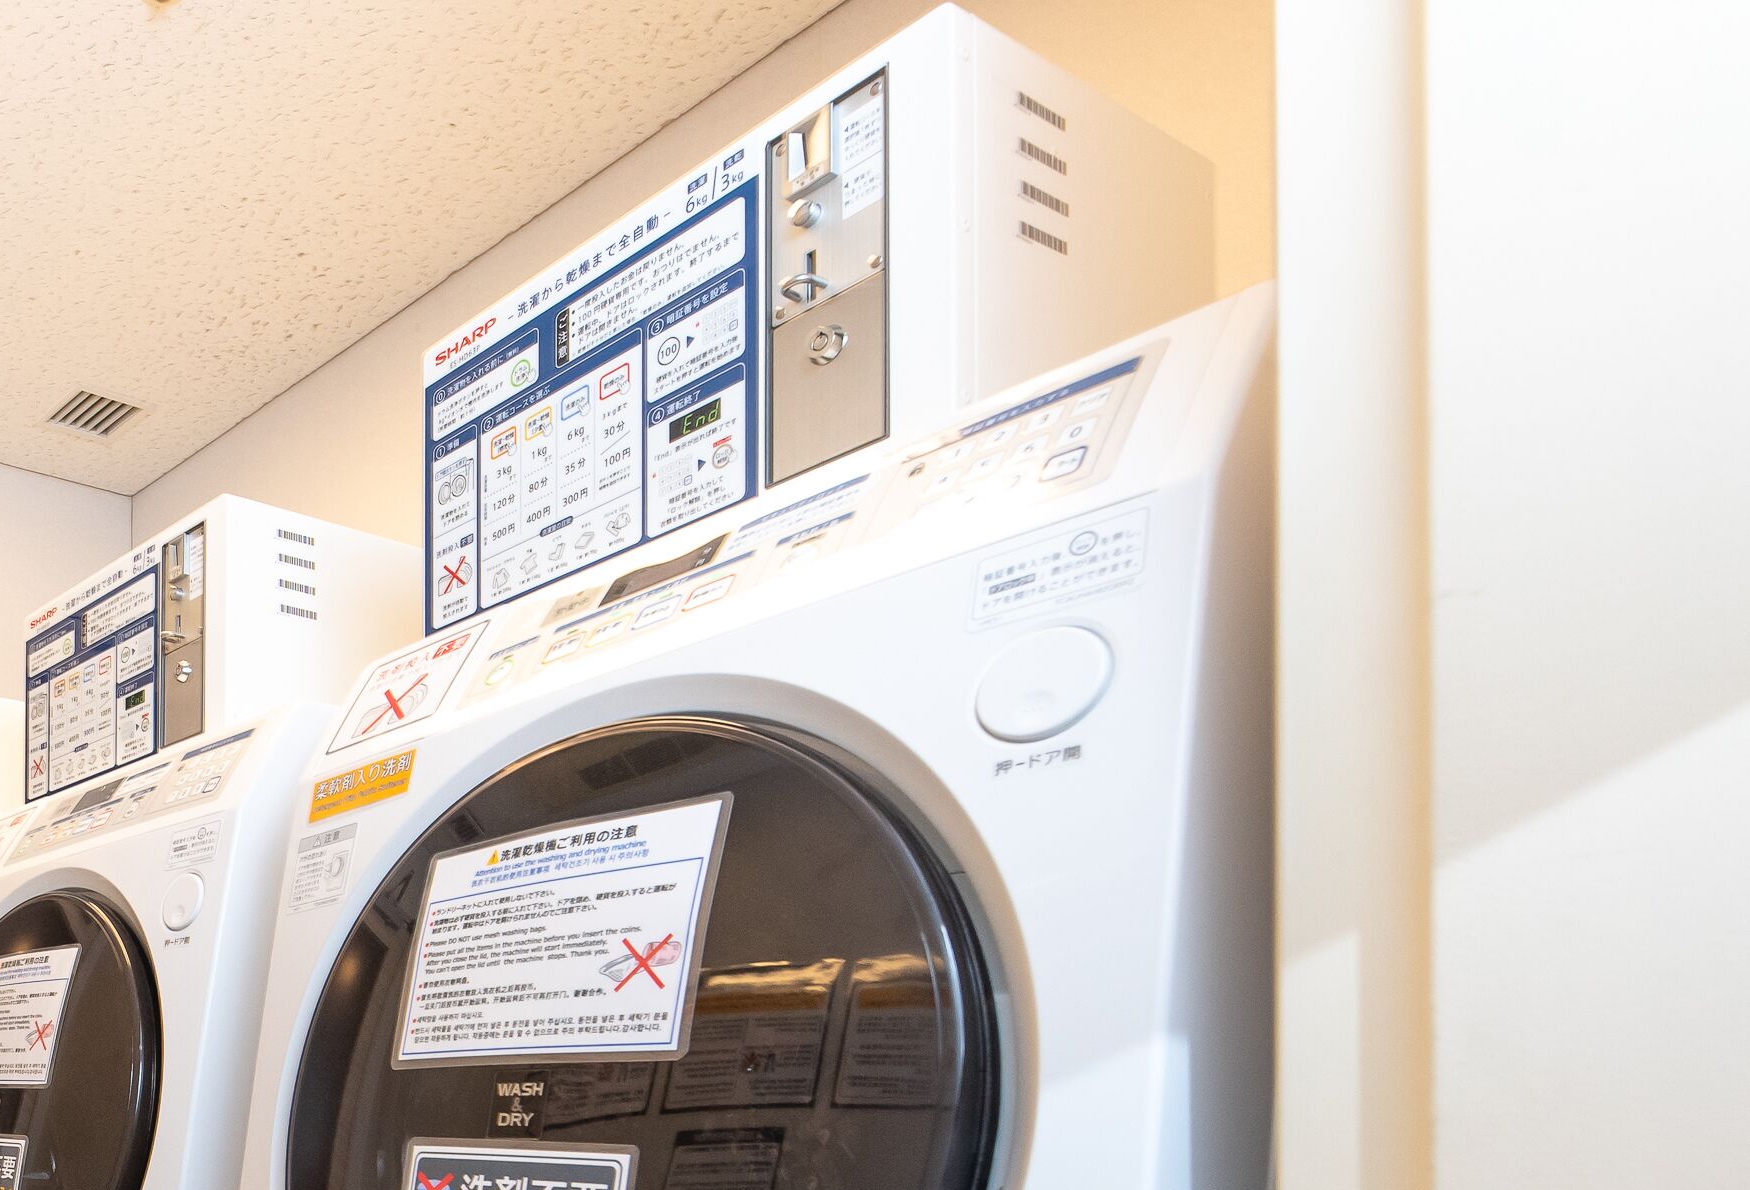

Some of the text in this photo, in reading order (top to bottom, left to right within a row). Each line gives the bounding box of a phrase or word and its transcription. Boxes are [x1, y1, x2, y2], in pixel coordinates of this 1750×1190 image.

[685, 170, 744, 213] 6kg 3kg
[666, 282, 729, 325] 暗証番号を設定
[435, 317, 497, 367] SHARP
[557, 314, 569, 360] ご注意
[660, 344, 677, 360] 100
[495, 386, 551, 424] 運転コースを選ぶ
[666, 390, 701, 417] 運転終了
[682, 399, 721, 436] End
[567, 426, 585, 441] 6kg
[603, 420, 625, 439] 30分
[532, 446, 547, 459] 1kg
[604, 446, 631, 468] 100円
[497, 465, 512, 479] 3kg
[565, 457, 586, 476] 35分
[528, 476, 548, 493] 80分
[492, 493, 516, 512] 120分
[563, 487, 589, 508] 300円
[526, 506, 551, 523] 400円
[492, 522, 516, 541] 500円
[30, 606, 58, 630] SHARP
[314, 750, 413, 802] 柔軟剤入り洗剤
[323, 830, 341, 845] 注意
[500, 824, 639, 862] 洗濯乾燥機ご利用の注意
[474, 840, 647, 878] Attention to use the washing and drying machine
[428, 949, 446, 958] Please
[446, 948, 456, 958] put
[465, 945, 475, 954] the
[476, 943, 494, 952] items
[494, 942, 501, 950] in
[502, 941, 513, 949] the
[514, 937, 542, 948] machine
[543, 934, 565, 944] before
[567, 933, 580, 944] you
[582, 930, 603, 940] insert
[605, 928, 618, 937] the
[619, 925, 642, 936] coins.
[430, 925, 546, 947] Please DO NOT use mesh washing bags.
[425, 967, 435, 975] You
[436, 965, 450, 974] can't
[451, 964, 465, 974] open
[486, 960, 501, 968] until
[516, 956, 544, 965] machine
[547, 953, 568, 964] stops.
[571, 950, 592, 959] Thank
[594, 948, 610, 959] you.
[426, 939, 608, 967] After you close the lid, the machine will start immediately.
[497, 1081, 545, 1097] WASH
[497, 1112, 535, 1127] DRY
